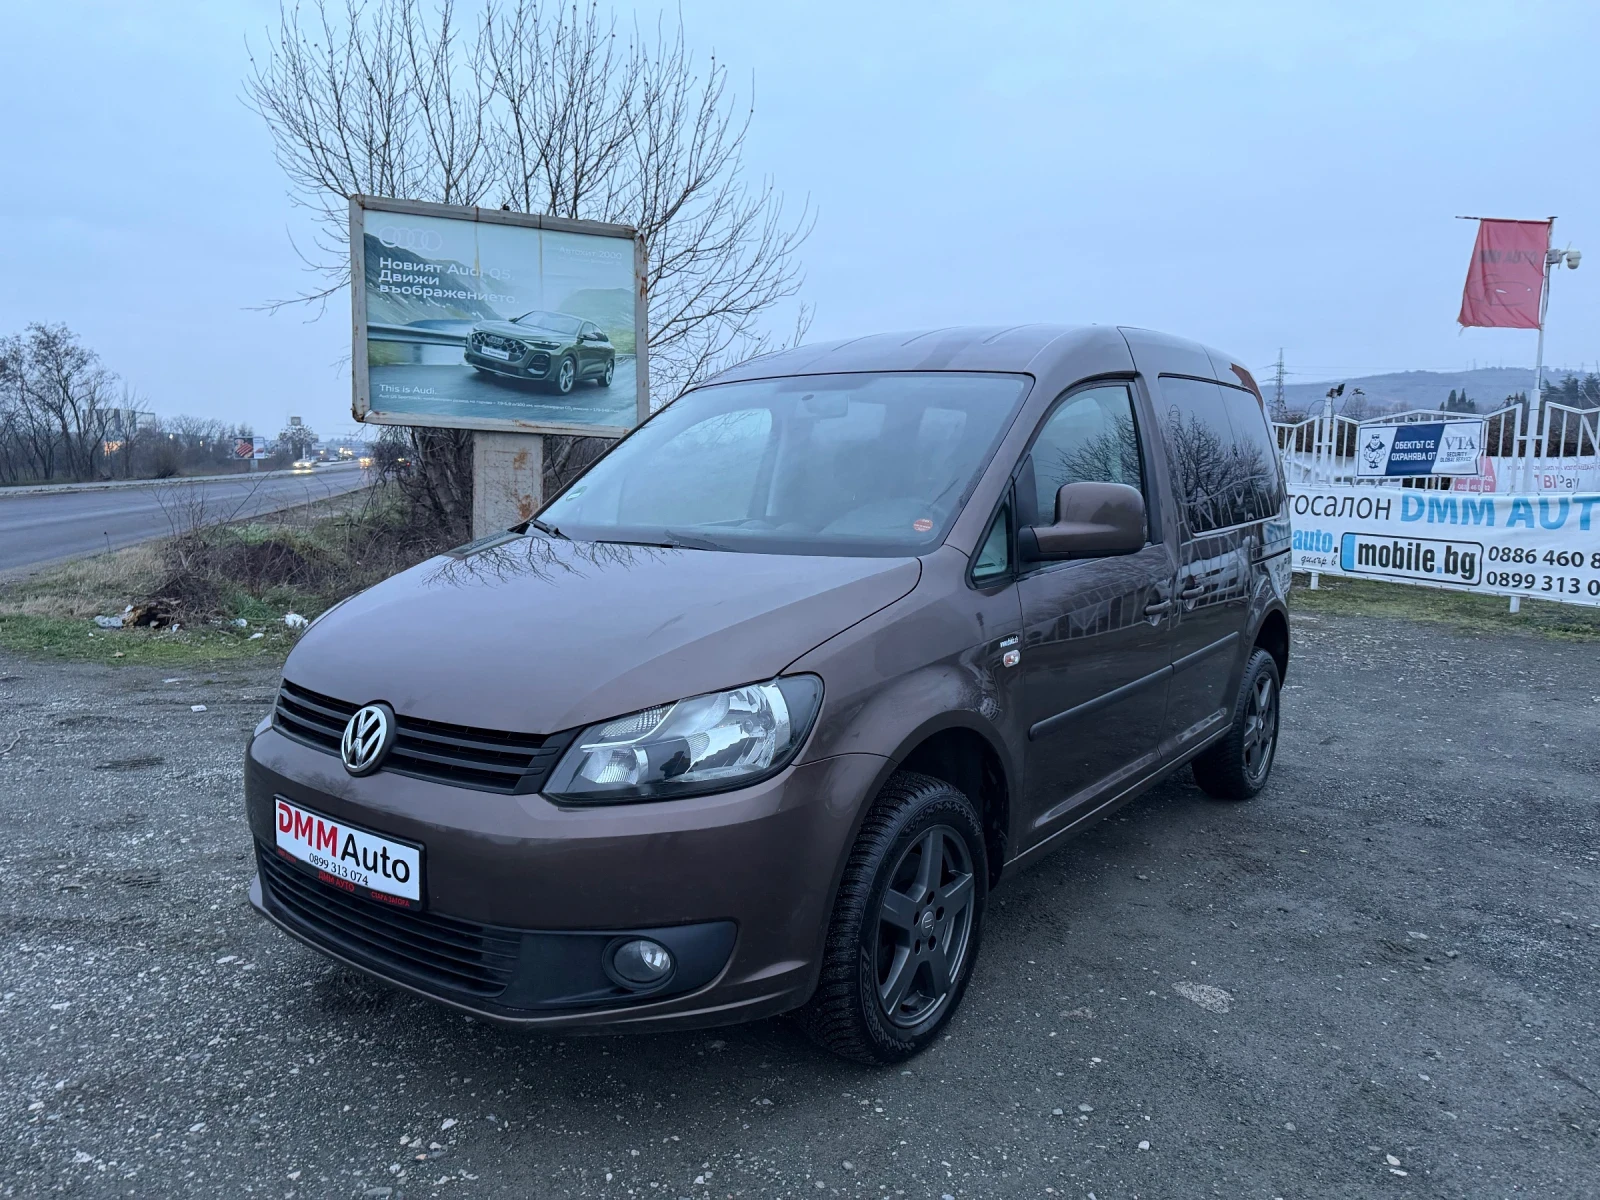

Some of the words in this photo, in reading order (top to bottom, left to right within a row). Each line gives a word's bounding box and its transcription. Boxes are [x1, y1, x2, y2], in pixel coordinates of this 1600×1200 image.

[599, 250, 623, 260] 2000
[379, 256, 443, 273] Новият
[447, 262, 484, 277] Audi
[378, 269, 440, 287] Движи
[379, 284, 520, 305] въображението.
[379, 384, 400, 393] This
[402, 385, 410, 394] is
[412, 386, 437, 395] Audi.
[1394, 440, 1424, 450] ОБЕКТЪТ
[1425, 440, 1435, 449] СЕ
[1444, 435, 1476, 450] VTA
[1391, 451, 1427, 461] ОХРАНЯВА
[1427, 451, 1437, 460] ОТ
[1400, 492, 1496, 527] DMM
[1506, 495, 1600, 531] AUT
[1357, 540, 1477, 580] mobile.bg
[1488, 546, 1537, 564] 0886
[1542, 549, 1585, 568] 460
[1486, 571, 1536, 589] 0899
[1541, 575, 1581, 594] 313
[309, 853, 329, 869] 0899
[331, 862, 348, 878] 313
[350, 870, 369, 886] 074
